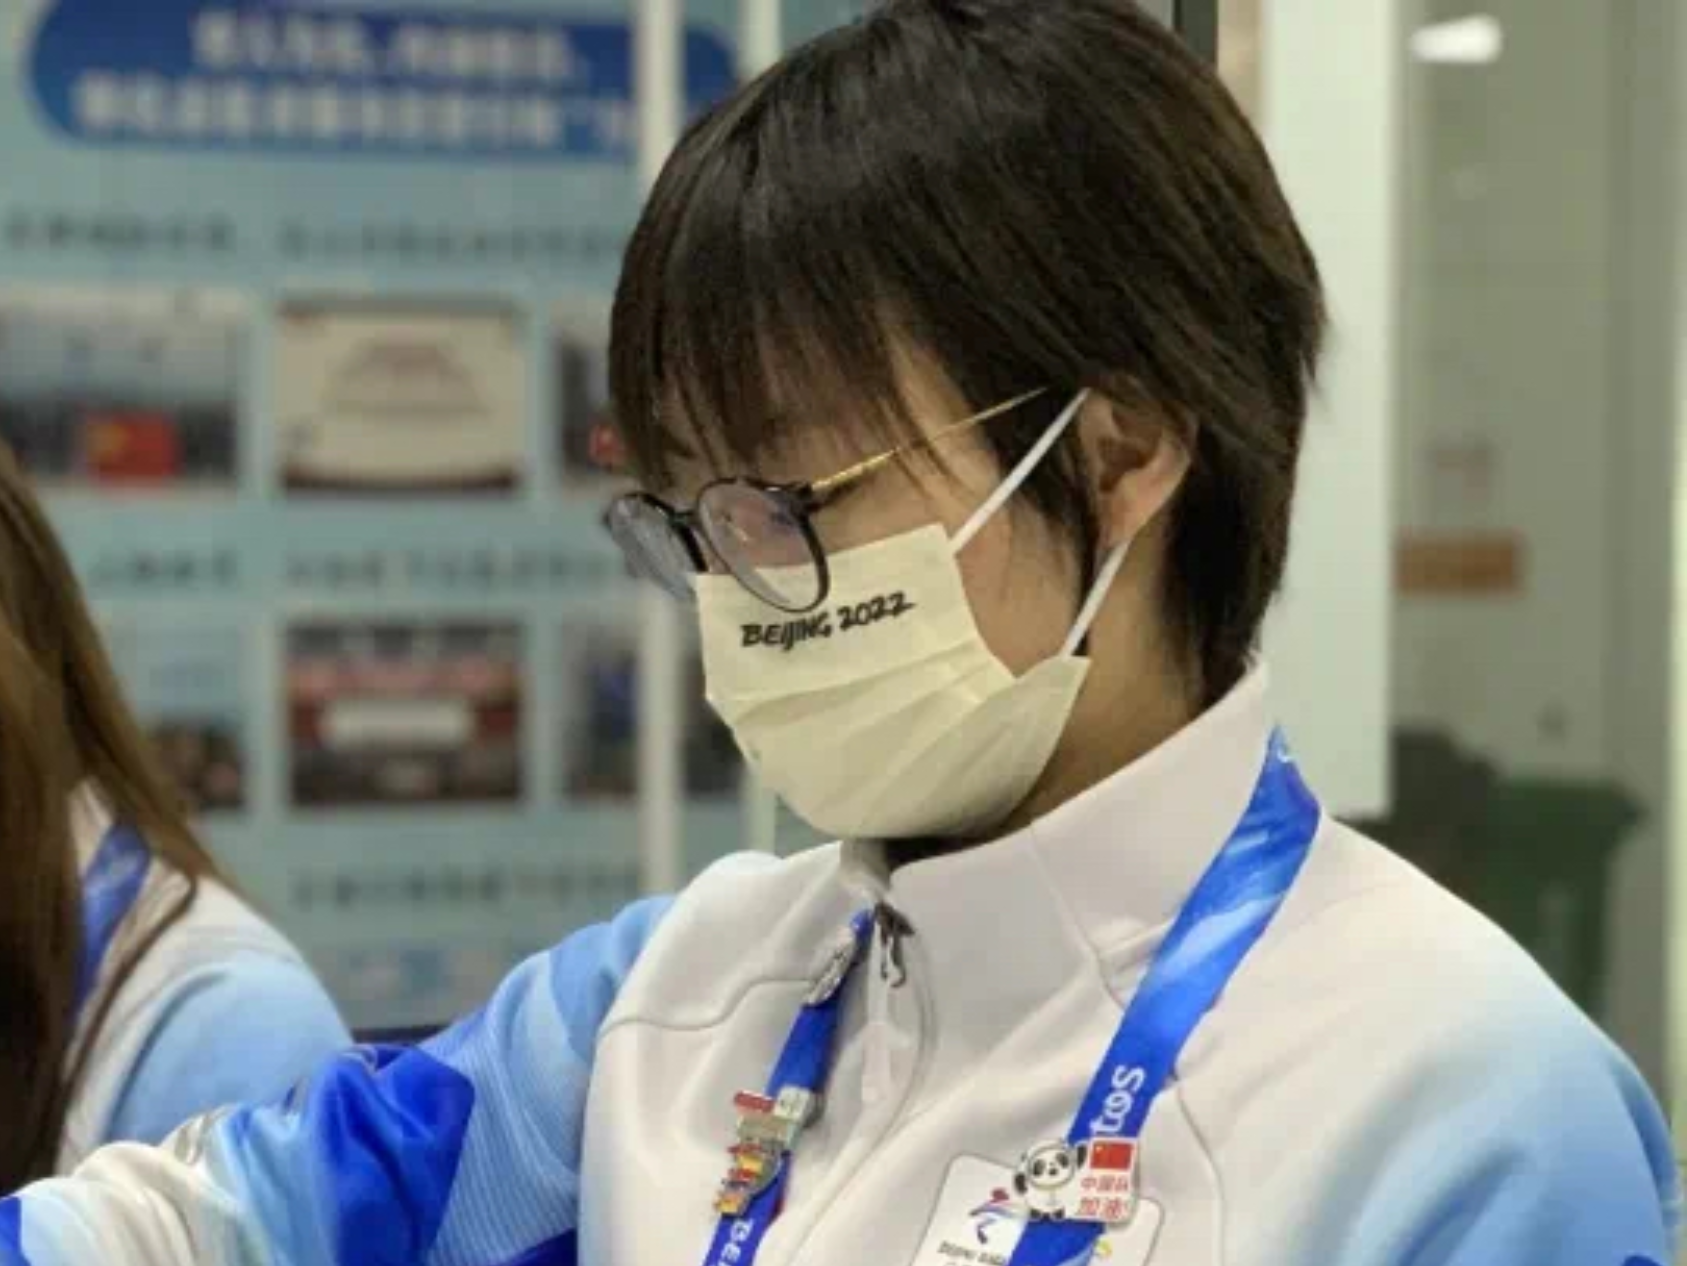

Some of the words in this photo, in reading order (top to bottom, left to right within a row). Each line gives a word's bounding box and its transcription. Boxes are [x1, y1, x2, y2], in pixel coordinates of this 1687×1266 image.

[740, 611, 832, 652] BEIJING
[837, 591, 916, 631] 2022
[1088, 1064, 1146, 1135] tos
